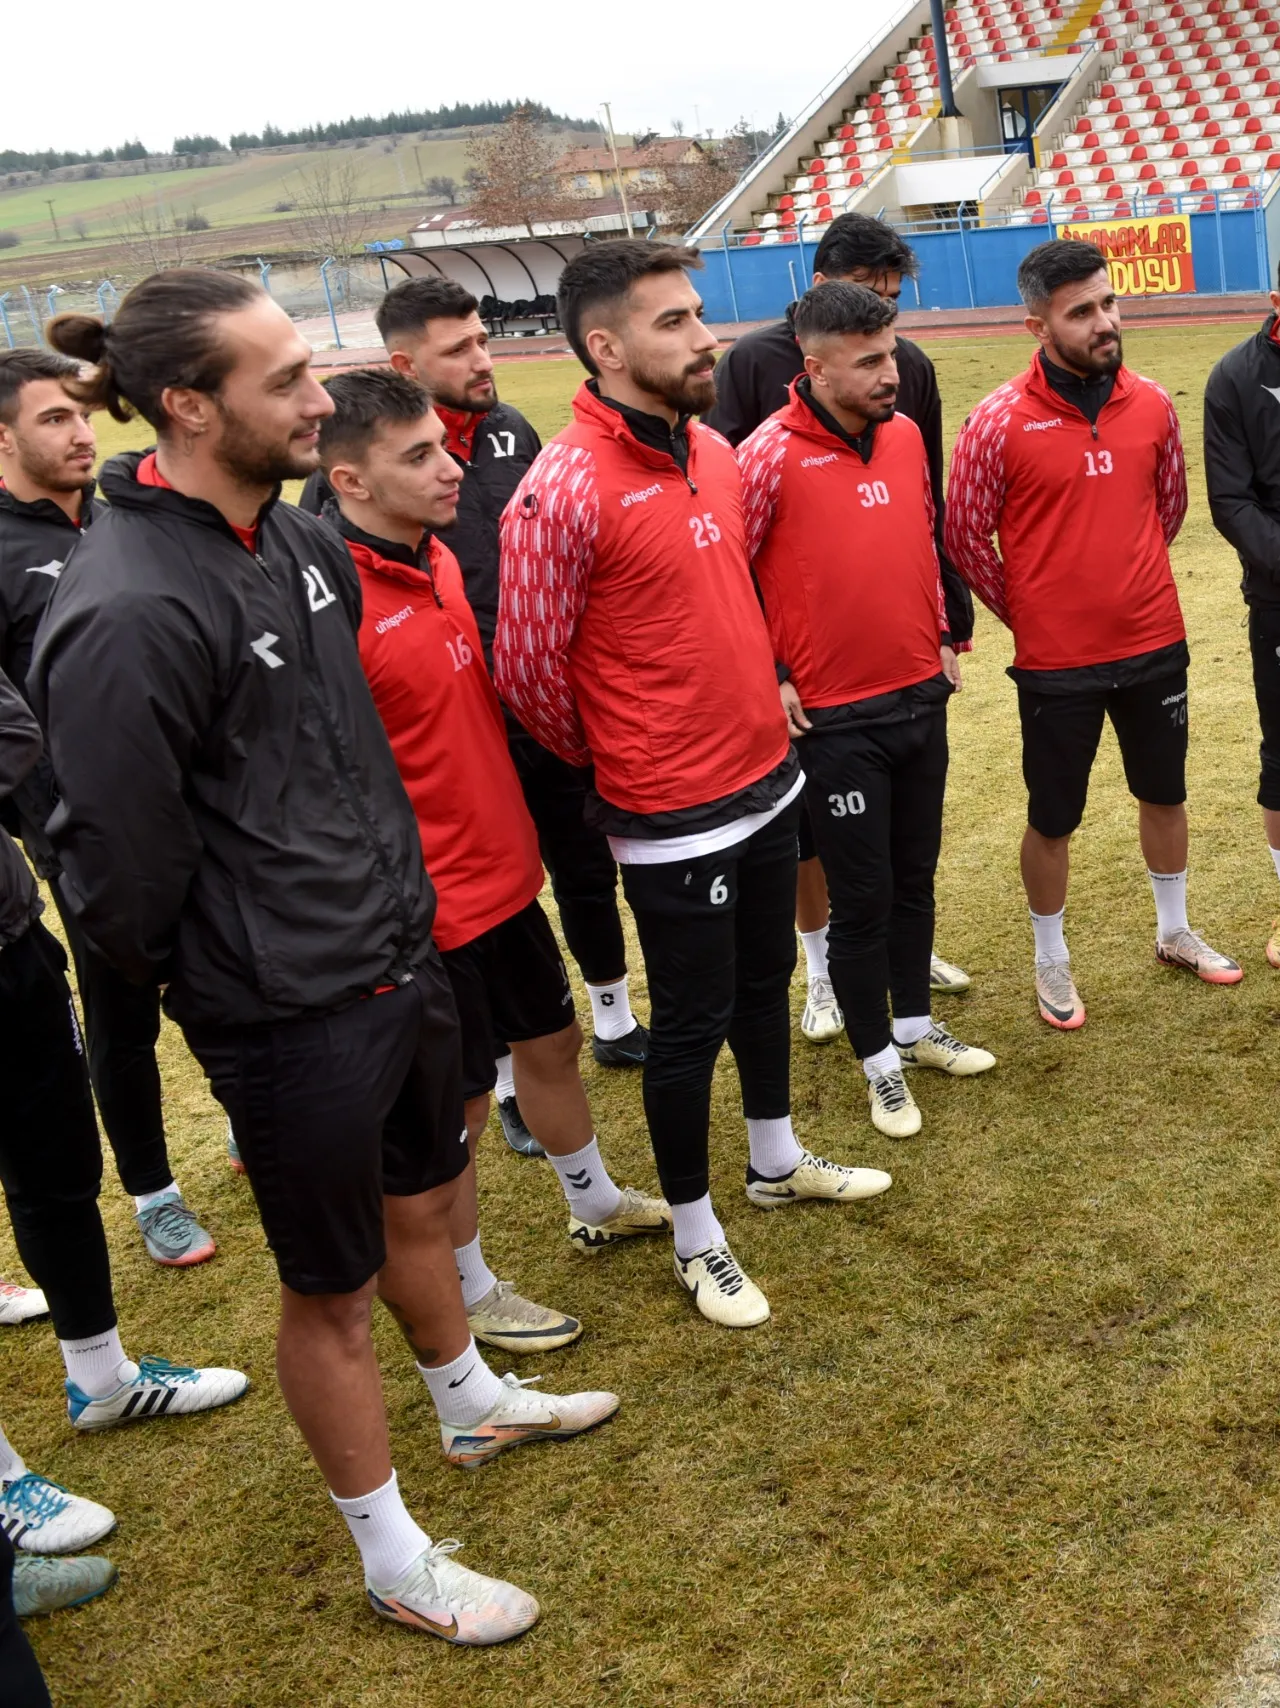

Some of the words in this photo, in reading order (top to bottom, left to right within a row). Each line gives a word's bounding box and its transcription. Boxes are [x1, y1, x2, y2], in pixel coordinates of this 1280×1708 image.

[1107, 257, 1181, 295] DUSU
[1023, 418, 1062, 431] uhlsport
[487, 431, 515, 458] 17
[800, 453, 839, 467] uhlsport
[1084, 450, 1113, 476] 13
[620, 483, 663, 507] uhlsport
[857, 480, 890, 507] 30
[689, 512, 721, 548] 25
[302, 565, 336, 612] 21
[375, 605, 414, 634] uhlsport
[446, 633, 472, 672] 16
[828, 790, 866, 817] 30
[710, 874, 728, 905] 6
